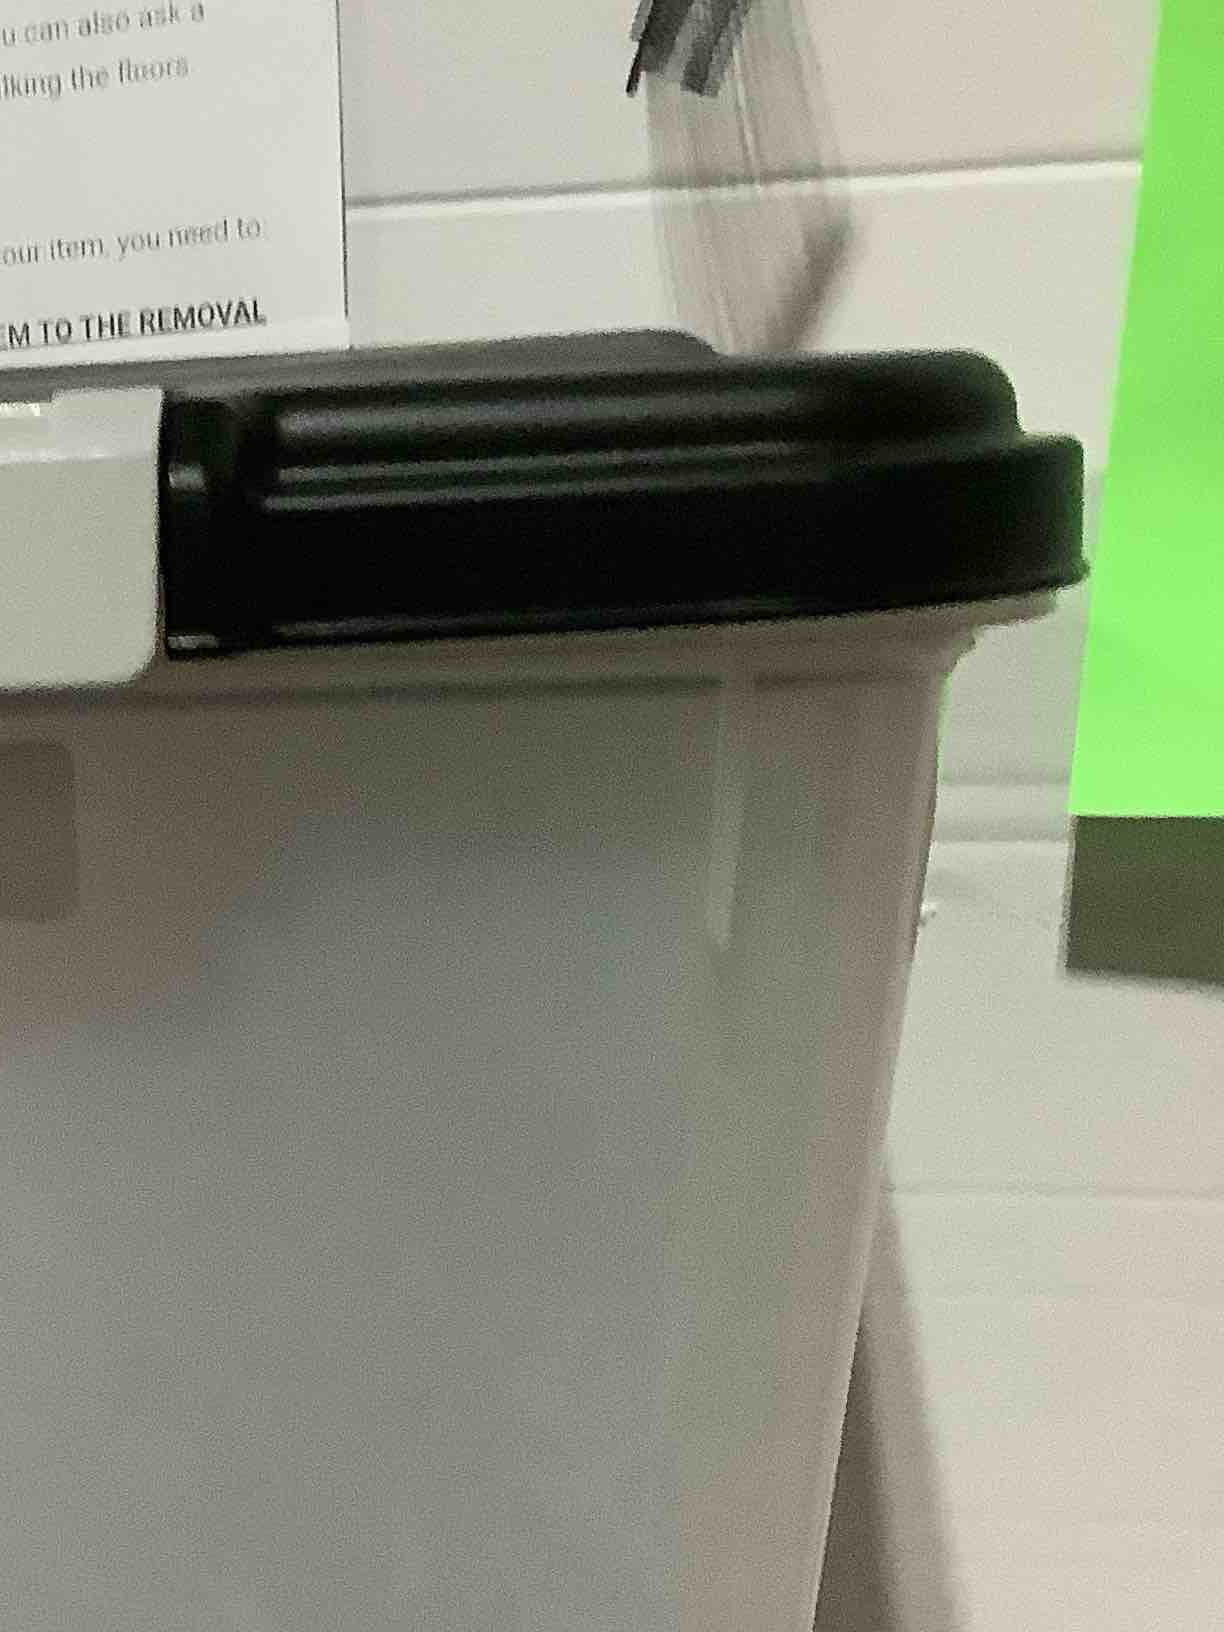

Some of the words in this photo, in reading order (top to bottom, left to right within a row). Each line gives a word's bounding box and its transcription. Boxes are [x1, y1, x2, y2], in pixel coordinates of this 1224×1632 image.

[24, 17, 69, 44] can
[77, 10, 131, 38] also
[138, 1, 181, 31] ask
[190, 2, 206, 23] a
[71, 63, 109, 92] the
[117, 54, 190, 84] floors
[117, 228, 161, 260] you
[169, 217, 229, 249] need
[38, 315, 74, 343] TO
[80, 306, 133, 340] THE
[138, 297, 269, 336] REMOVAL
